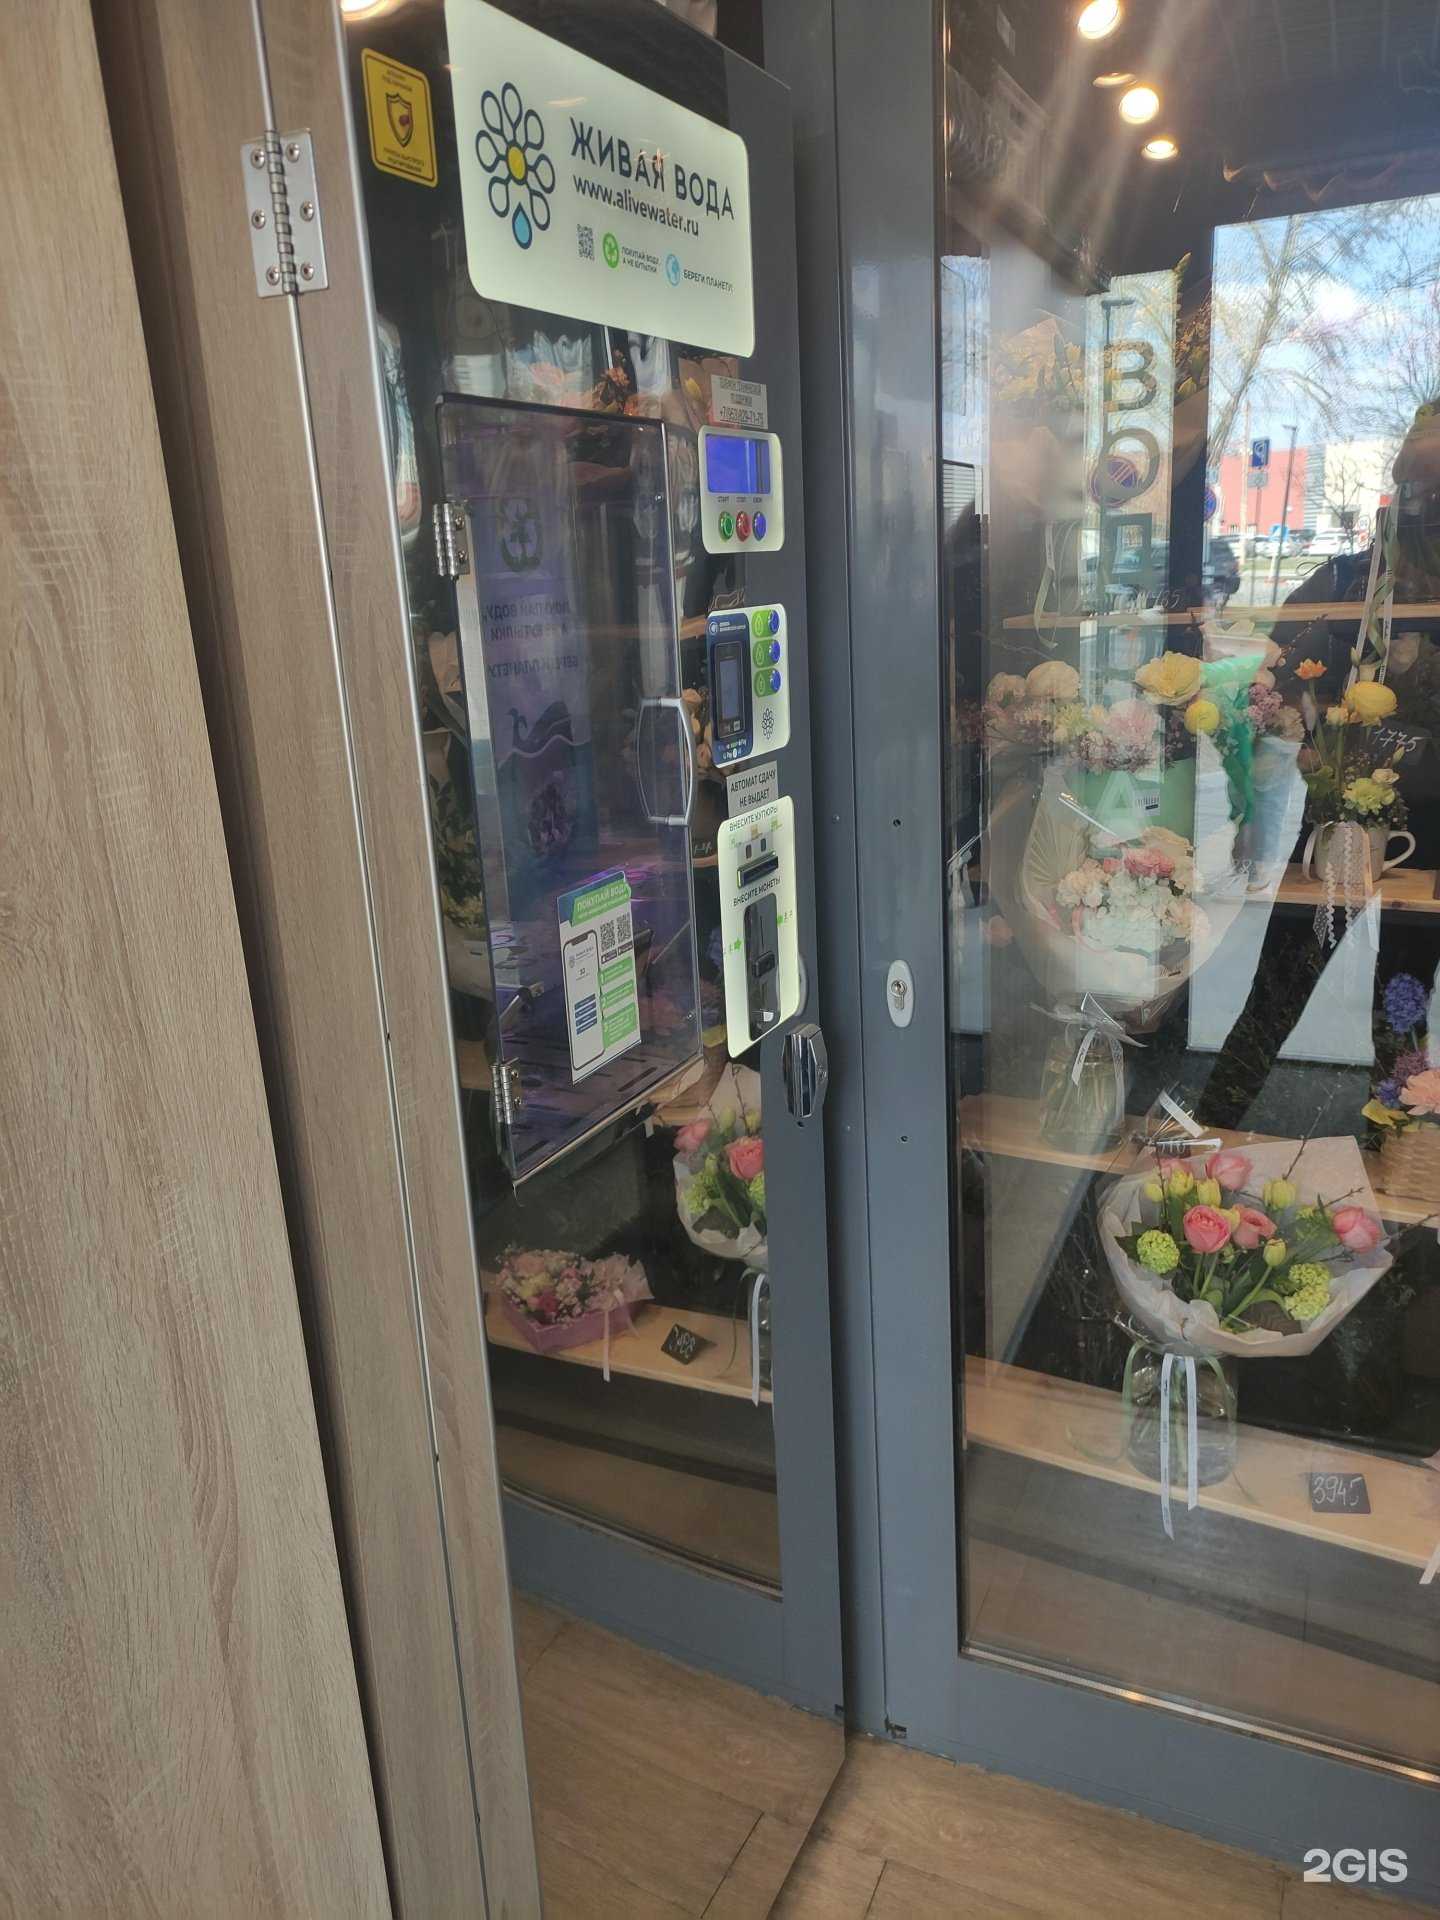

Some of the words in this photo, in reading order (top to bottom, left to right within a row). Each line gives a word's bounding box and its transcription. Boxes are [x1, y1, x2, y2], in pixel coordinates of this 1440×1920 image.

[570, 116, 665, 193] ЖИВАЯ
[674, 163, 735, 222] ВОДА
[573, 175, 699, 237] www.alivewater.ru
[683, 268, 705, 284] БЕРЕГИ
[731, 775, 758, 793] АВТОМАТ
[758, 769, 777, 785] СДАЧУ
[739, 796, 748, 808] НЕ
[748, 788, 770, 806] ВЫДАЕТ
[730, 814, 754, 832] ВНЕСИТЕ
[733, 887, 758, 907] ВНЕСИТЕ
[758, 876, 781, 895] МОНЕТЫ
[1312, 1475, 1363, 1507] 3945
